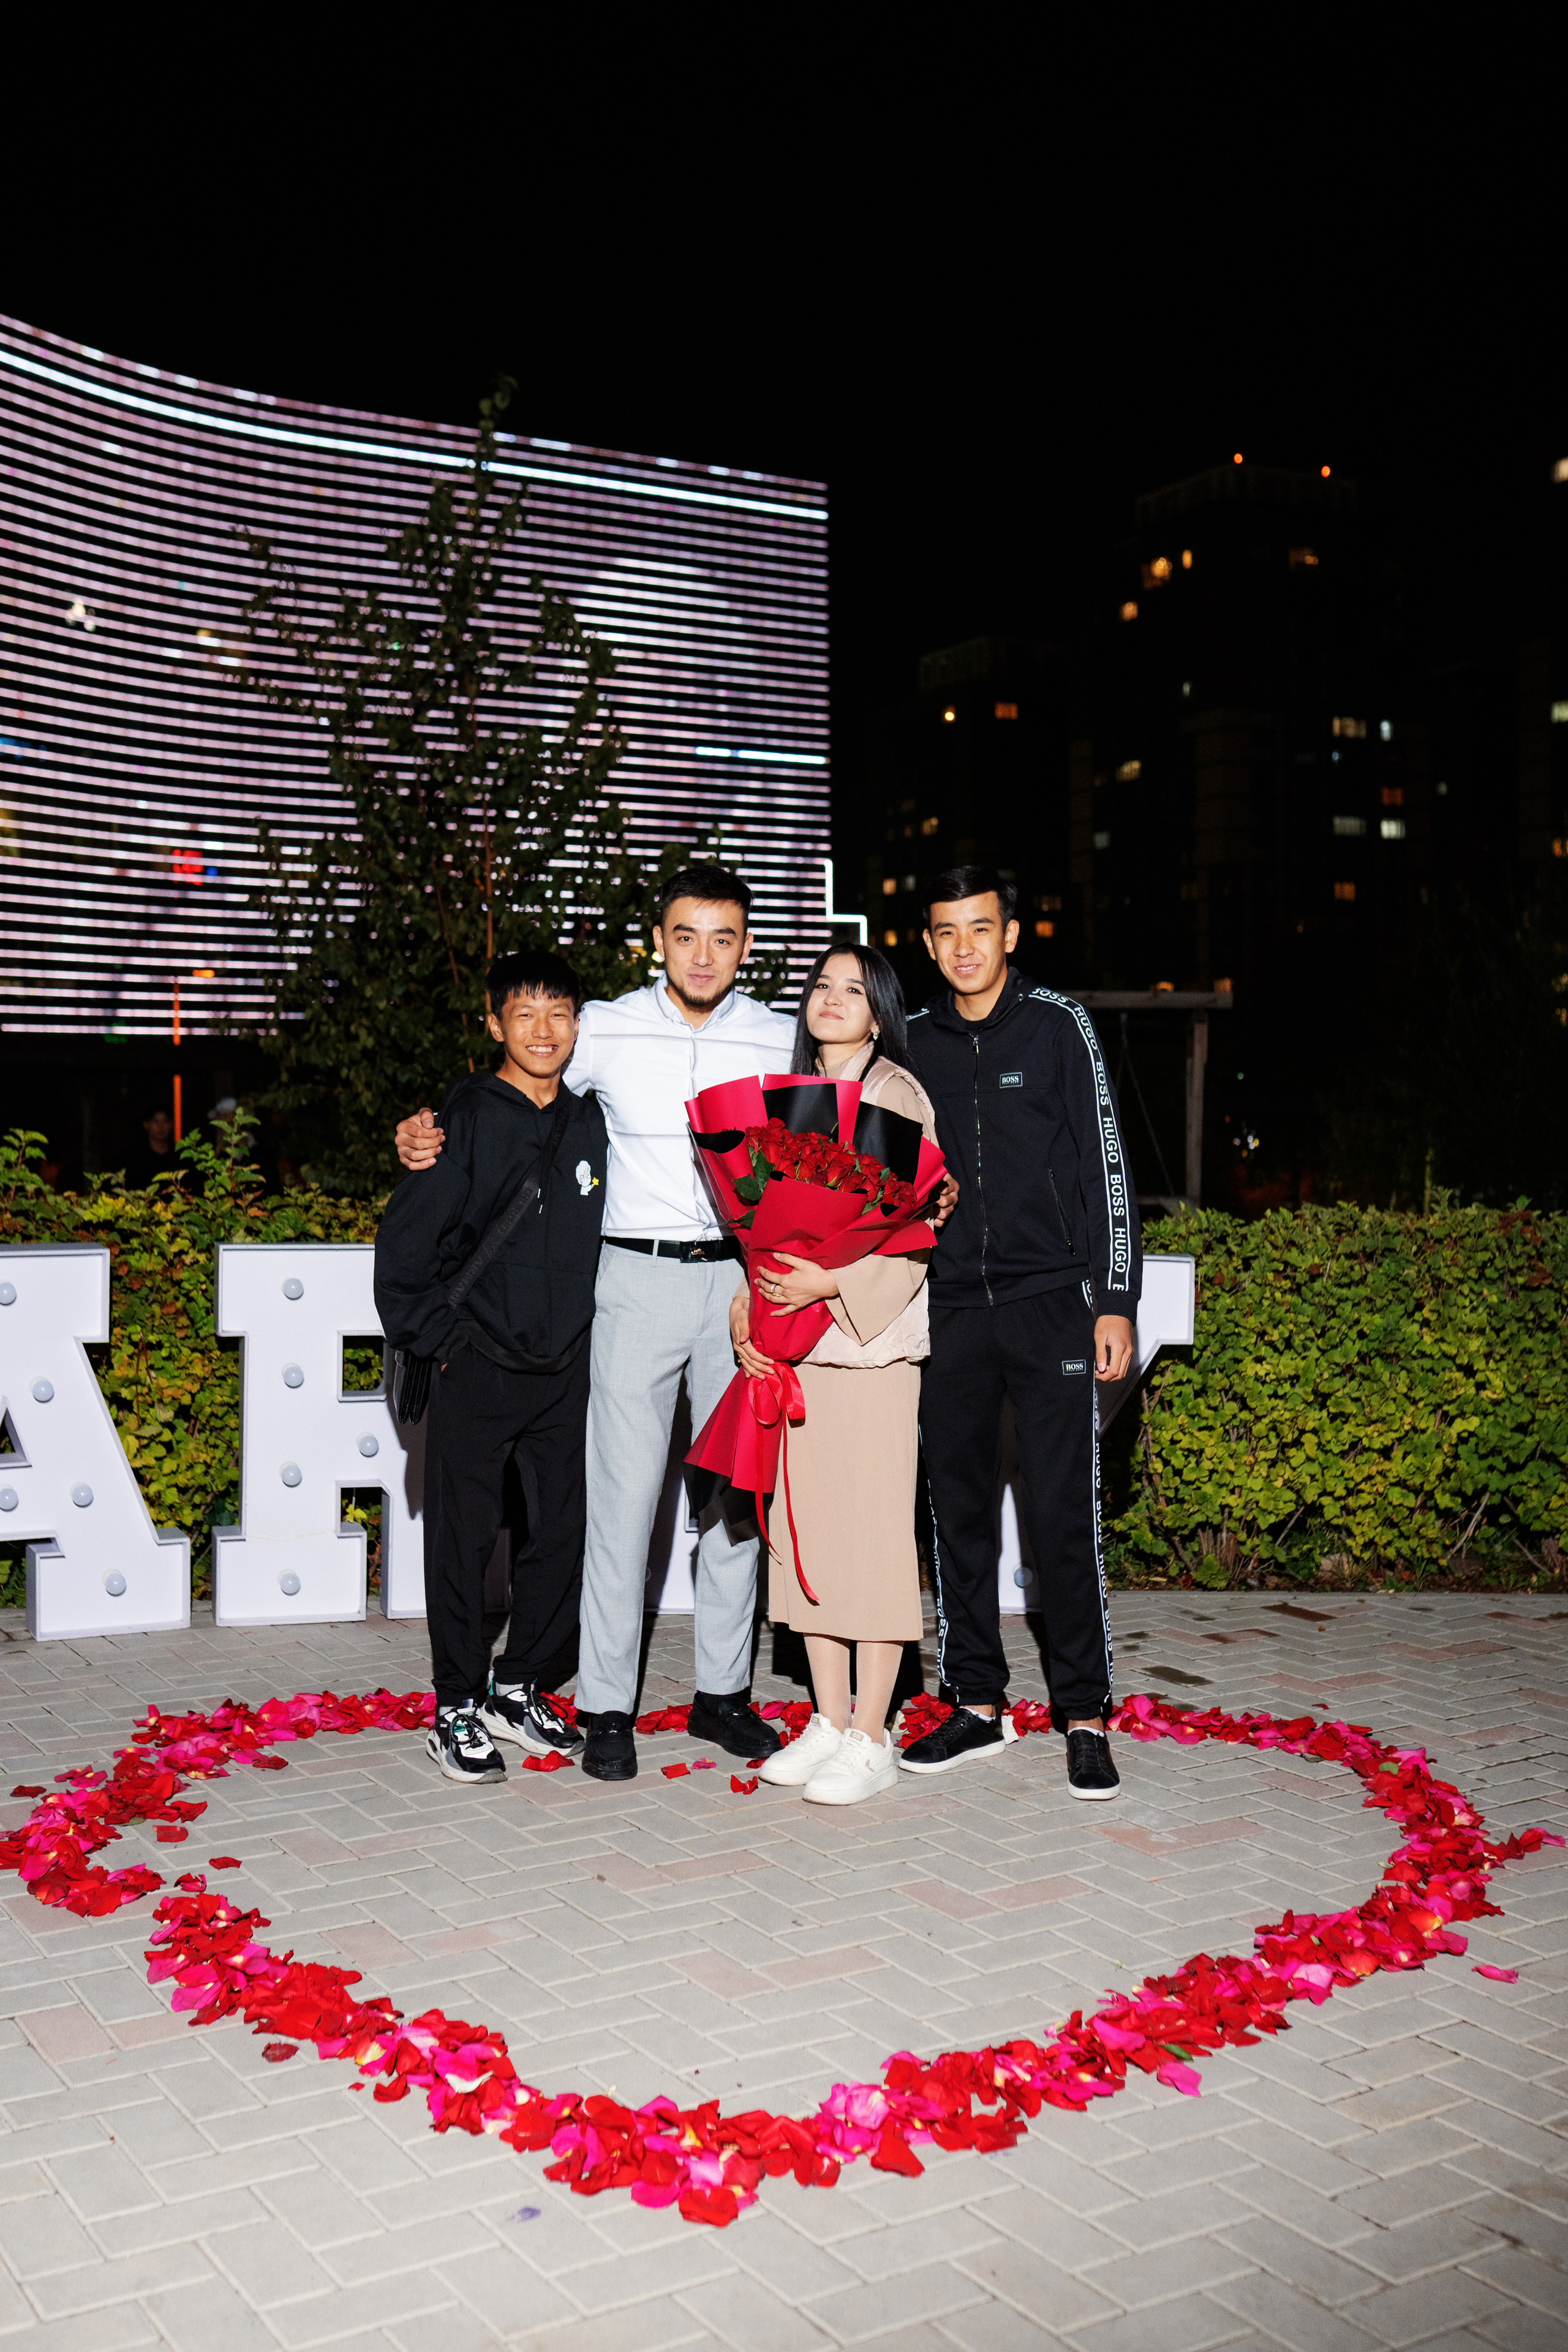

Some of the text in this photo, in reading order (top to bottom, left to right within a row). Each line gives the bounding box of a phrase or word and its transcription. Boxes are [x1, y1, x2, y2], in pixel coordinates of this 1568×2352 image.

[1074, 1006, 1098, 1050] HUGO
[1096, 1061, 1109, 1106] BOSS
[1103, 1117, 1119, 1163] HUGO
[1110, 1174, 1125, 1216] BOSS
[1114, 1227, 1126, 1273] HUGO
